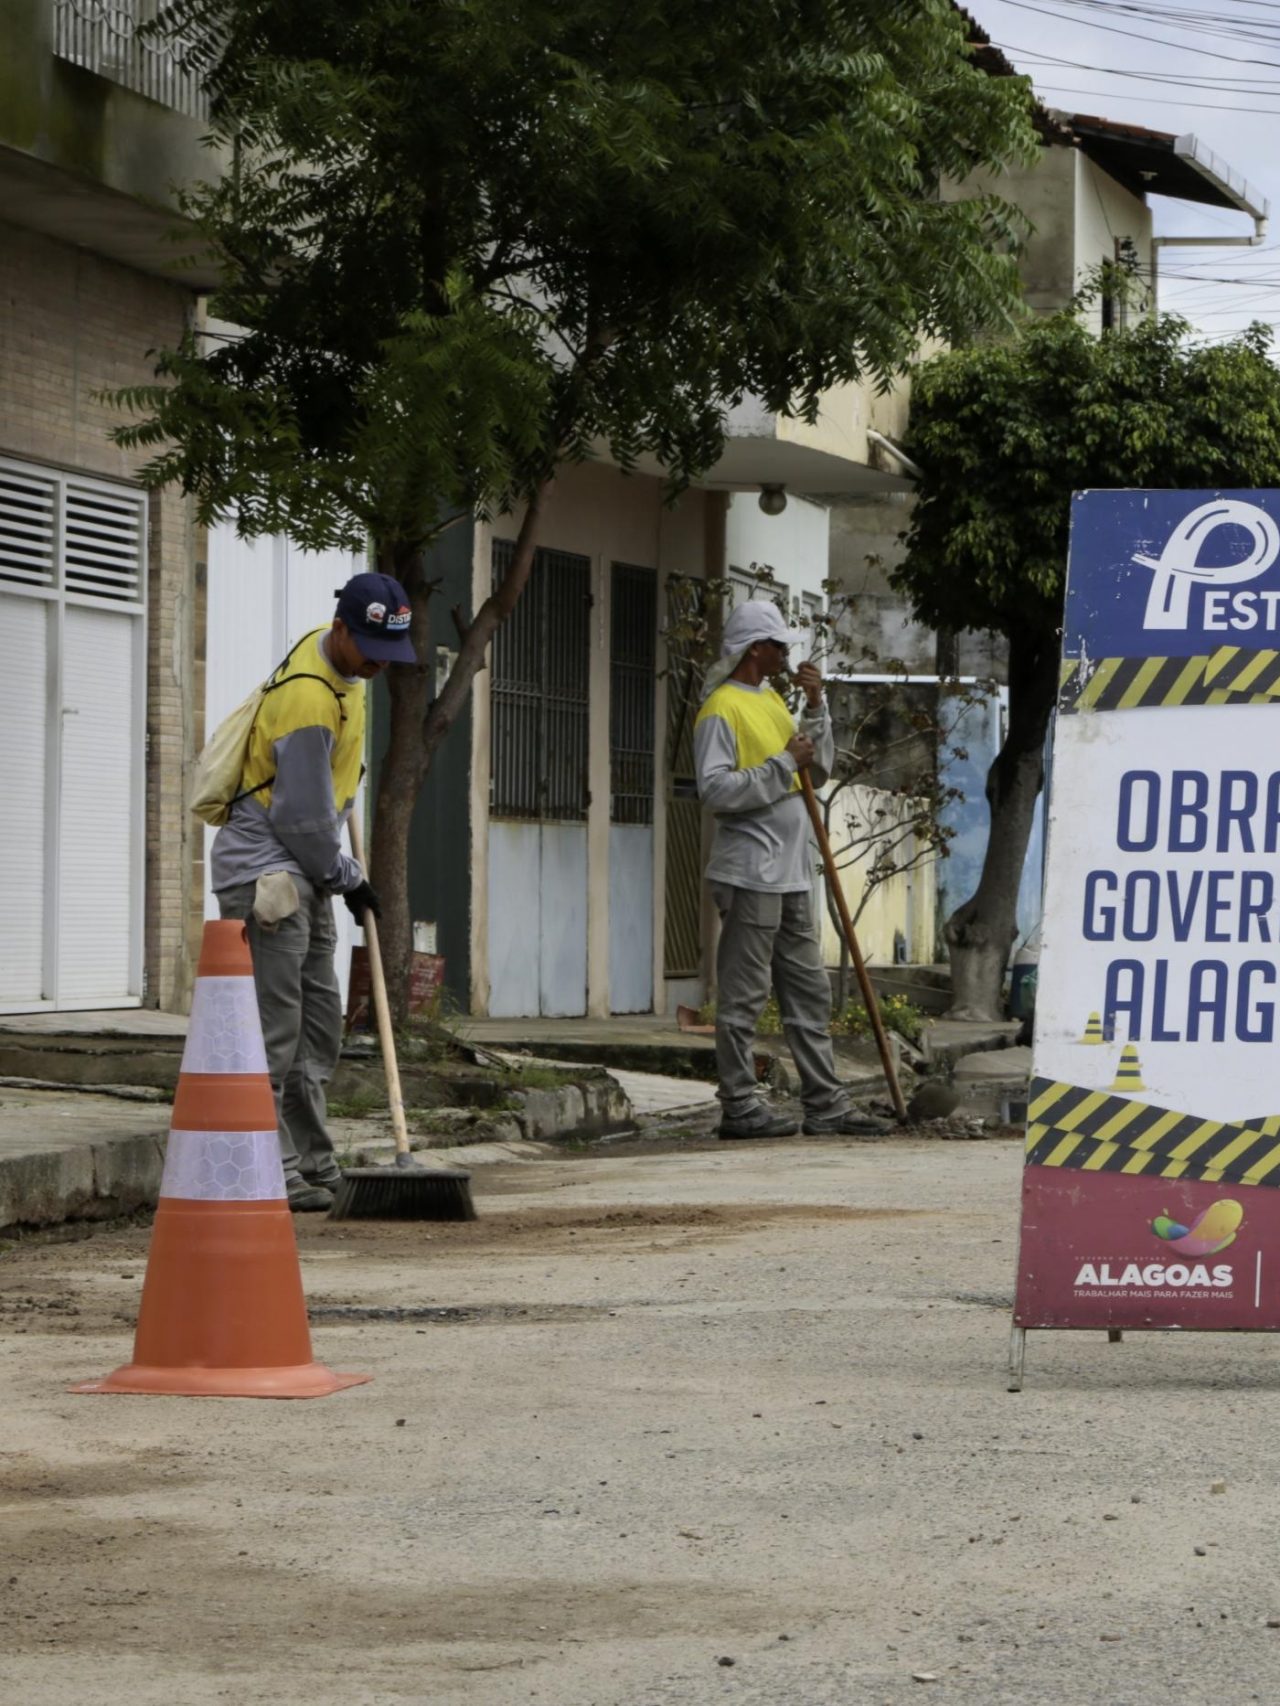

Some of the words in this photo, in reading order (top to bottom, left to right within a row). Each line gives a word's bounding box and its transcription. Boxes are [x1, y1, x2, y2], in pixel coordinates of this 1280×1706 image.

[1073, 1263, 1234, 1287] ALAGOAS
[1073, 1289, 1128, 1298] TRABALHAR
[1129, 1290, 1152, 1298] MAIS
[1153, 1290, 1178, 1299] PARA
[1179, 1290, 1209, 1299] FAZER
[1210, 1291, 1234, 1299] MAIS
